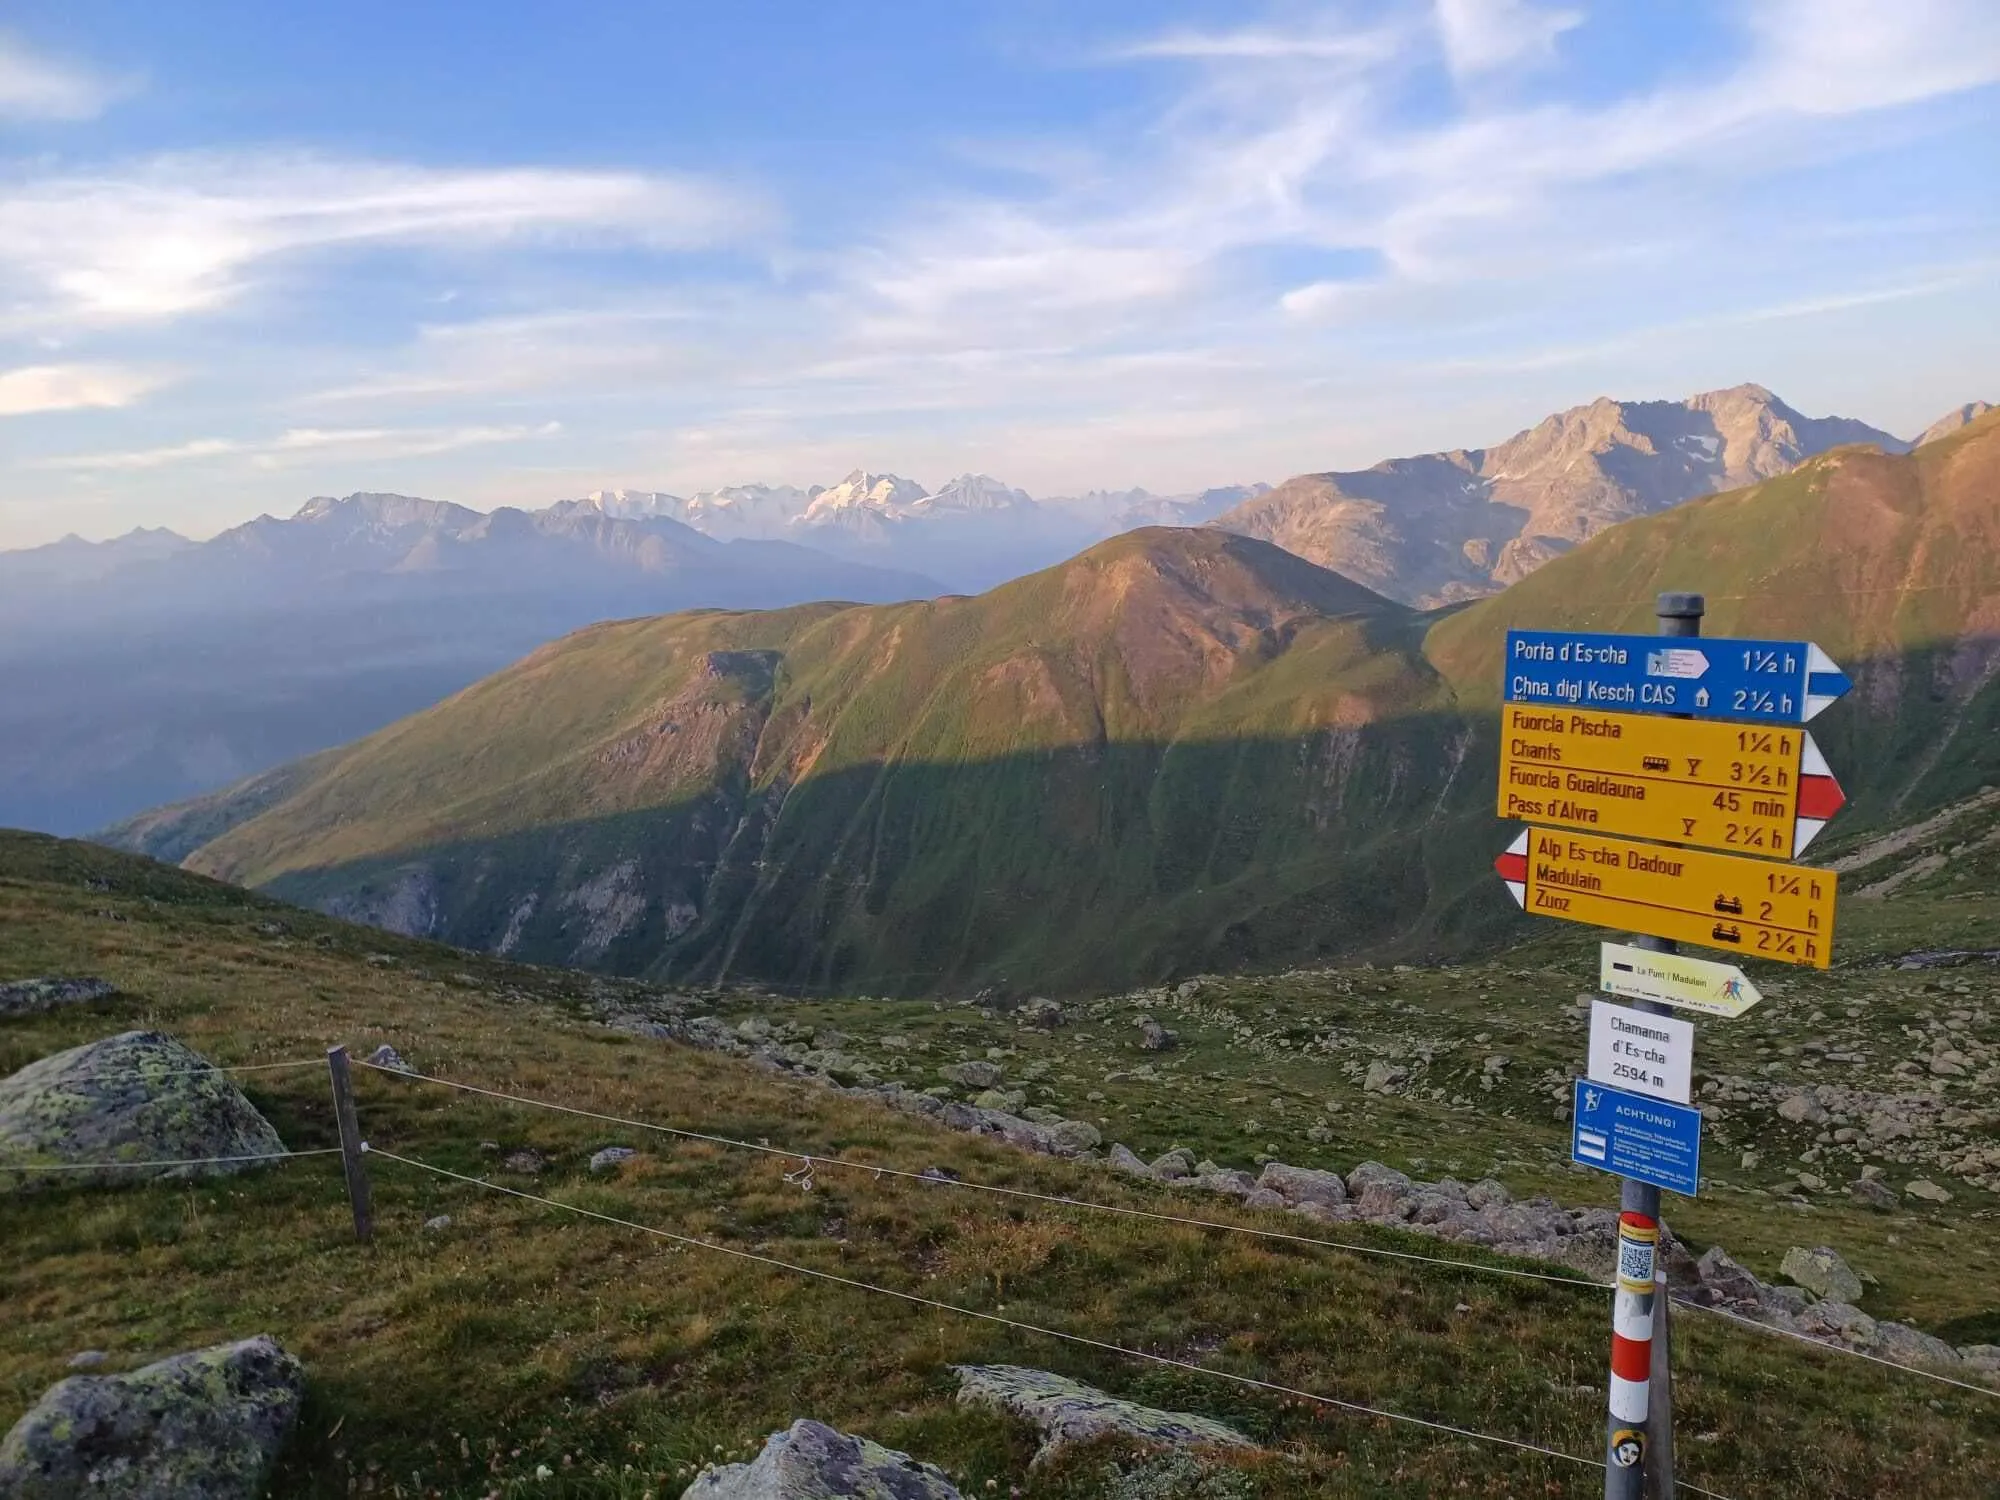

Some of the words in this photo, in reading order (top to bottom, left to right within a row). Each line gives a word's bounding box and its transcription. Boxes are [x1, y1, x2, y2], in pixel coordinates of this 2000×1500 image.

[1515, 640, 1554, 661] Porta
[1785, 652, 1796, 674] h
[1513, 676, 1553, 697] Chna.
[1556, 678, 1582, 703] digl
[1588, 680, 1635, 703] Kesch
[1641, 683, 1676, 705] CAS
[1782, 693, 1793, 714] h
[1513, 711, 1564, 733] Fuorcla
[1570, 715, 1621, 738] Pischa
[1780, 735, 1791, 756] h
[1510, 766, 1560, 789] Fuorcla
[1566, 773, 1646, 800] Gualdauna
[1712, 792, 1741, 812] 45
[1752, 798, 1785, 818] min
[1777, 767, 1788, 787] h
[1508, 793, 1543, 815] Pass
[1547, 800, 1598, 823] d'Alvra
[1771, 829, 1782, 849] h
[1538, 837, 1562, 861] Alp
[1568, 841, 1620, 867] Es-cha
[1627, 851, 1685, 877] Dadour
[1810, 880, 1821, 900] h
[1536, 863, 1602, 891] Madulain
[1760, 901, 1773, 921] 2
[1808, 908, 1818, 929] h
[1535, 889, 1570, 912] Zuoz
[1805, 939, 1816, 958] h
[1610, 1016, 1670, 1042] Chamanna
[1612, 1062, 1648, 1082] 2594
[1653, 1075, 1664, 1088] m
